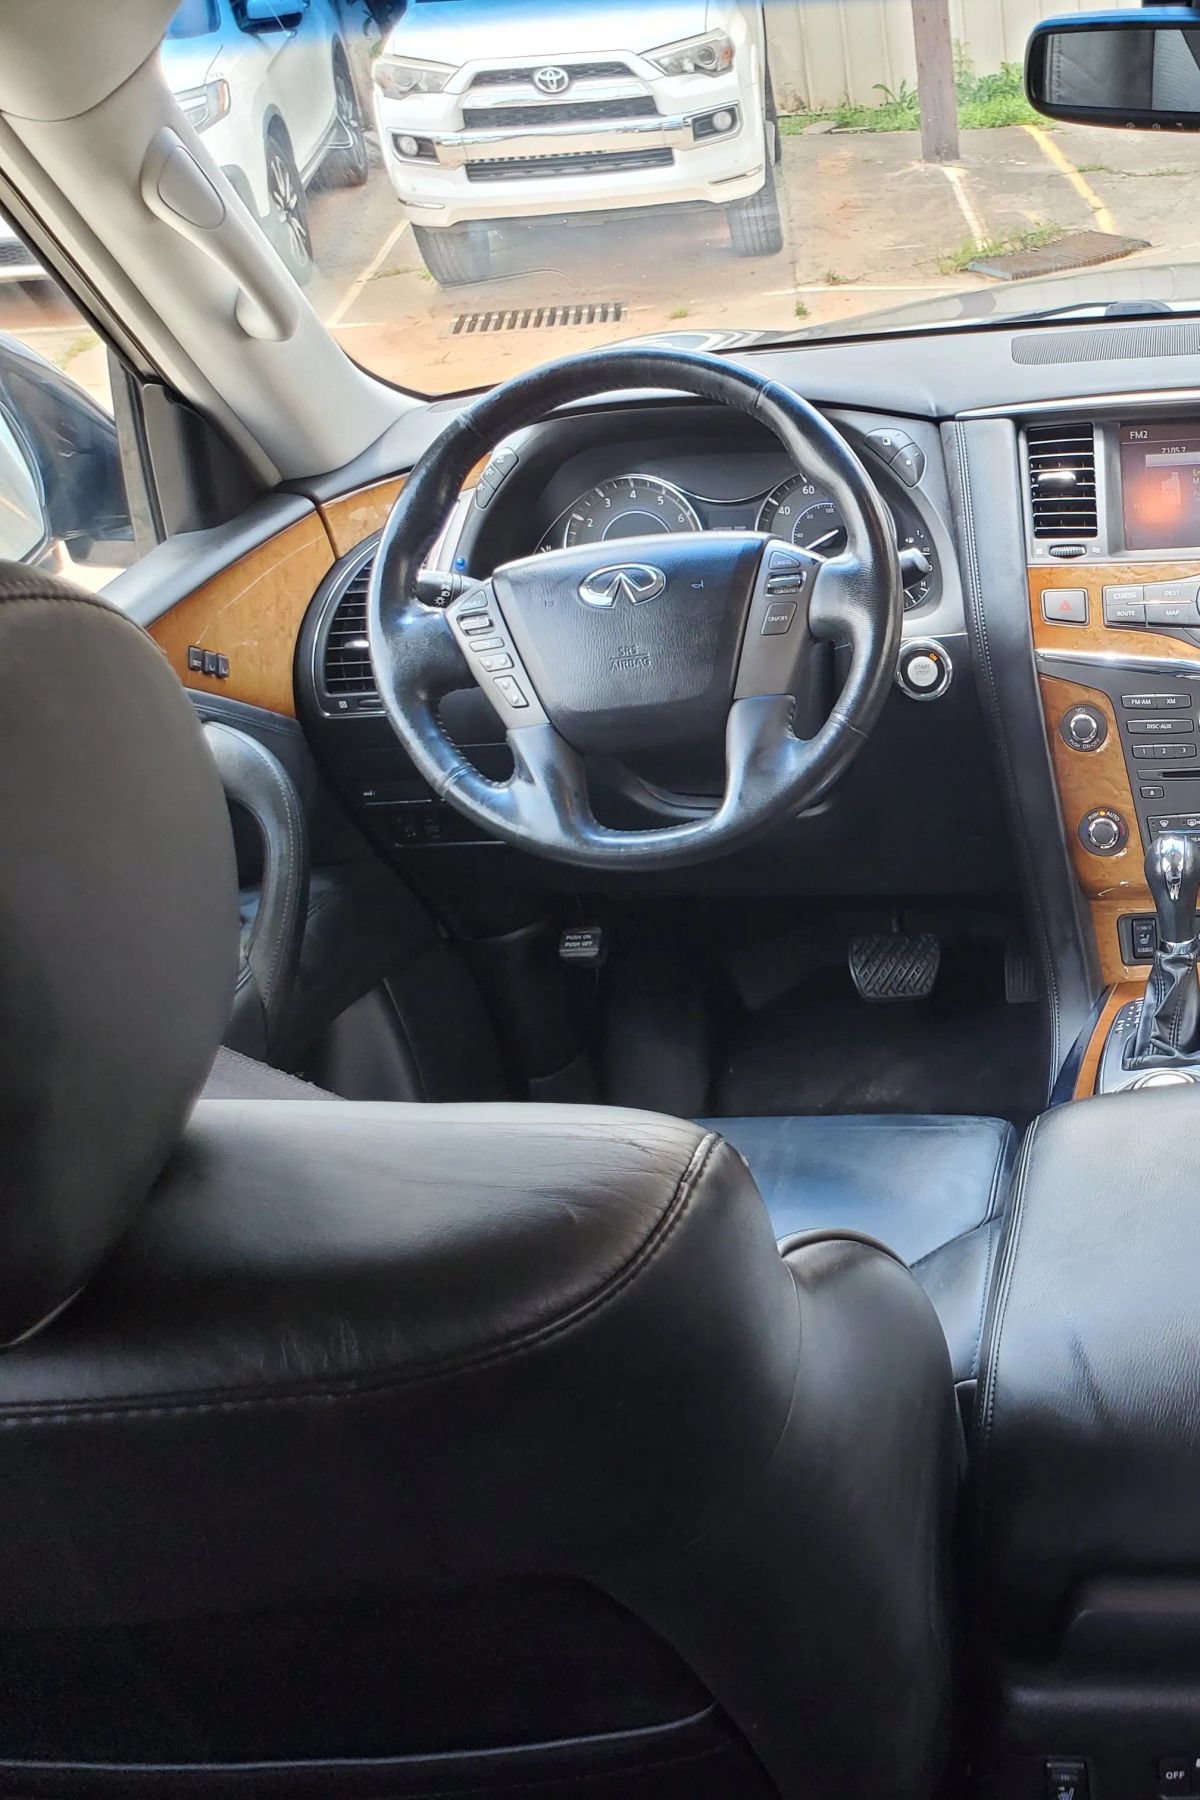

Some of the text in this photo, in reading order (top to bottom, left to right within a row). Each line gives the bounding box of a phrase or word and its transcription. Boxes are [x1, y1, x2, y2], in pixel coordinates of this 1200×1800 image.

[1129, 430, 1148, 440] FM2
[629, 489, 637, 499] 4
[802, 485, 815, 495] 60
[604, 498, 611, 508] 3
[657, 496, 664, 505] 5
[778, 506, 791, 516] 40
[587, 518, 594, 528] 2
[677, 513, 685, 523] 6
[609, 657, 652, 671] AIRBAG
[1106, 811, 1120, 822] AUTO
[1165, 1771, 1185, 1780] OFF
